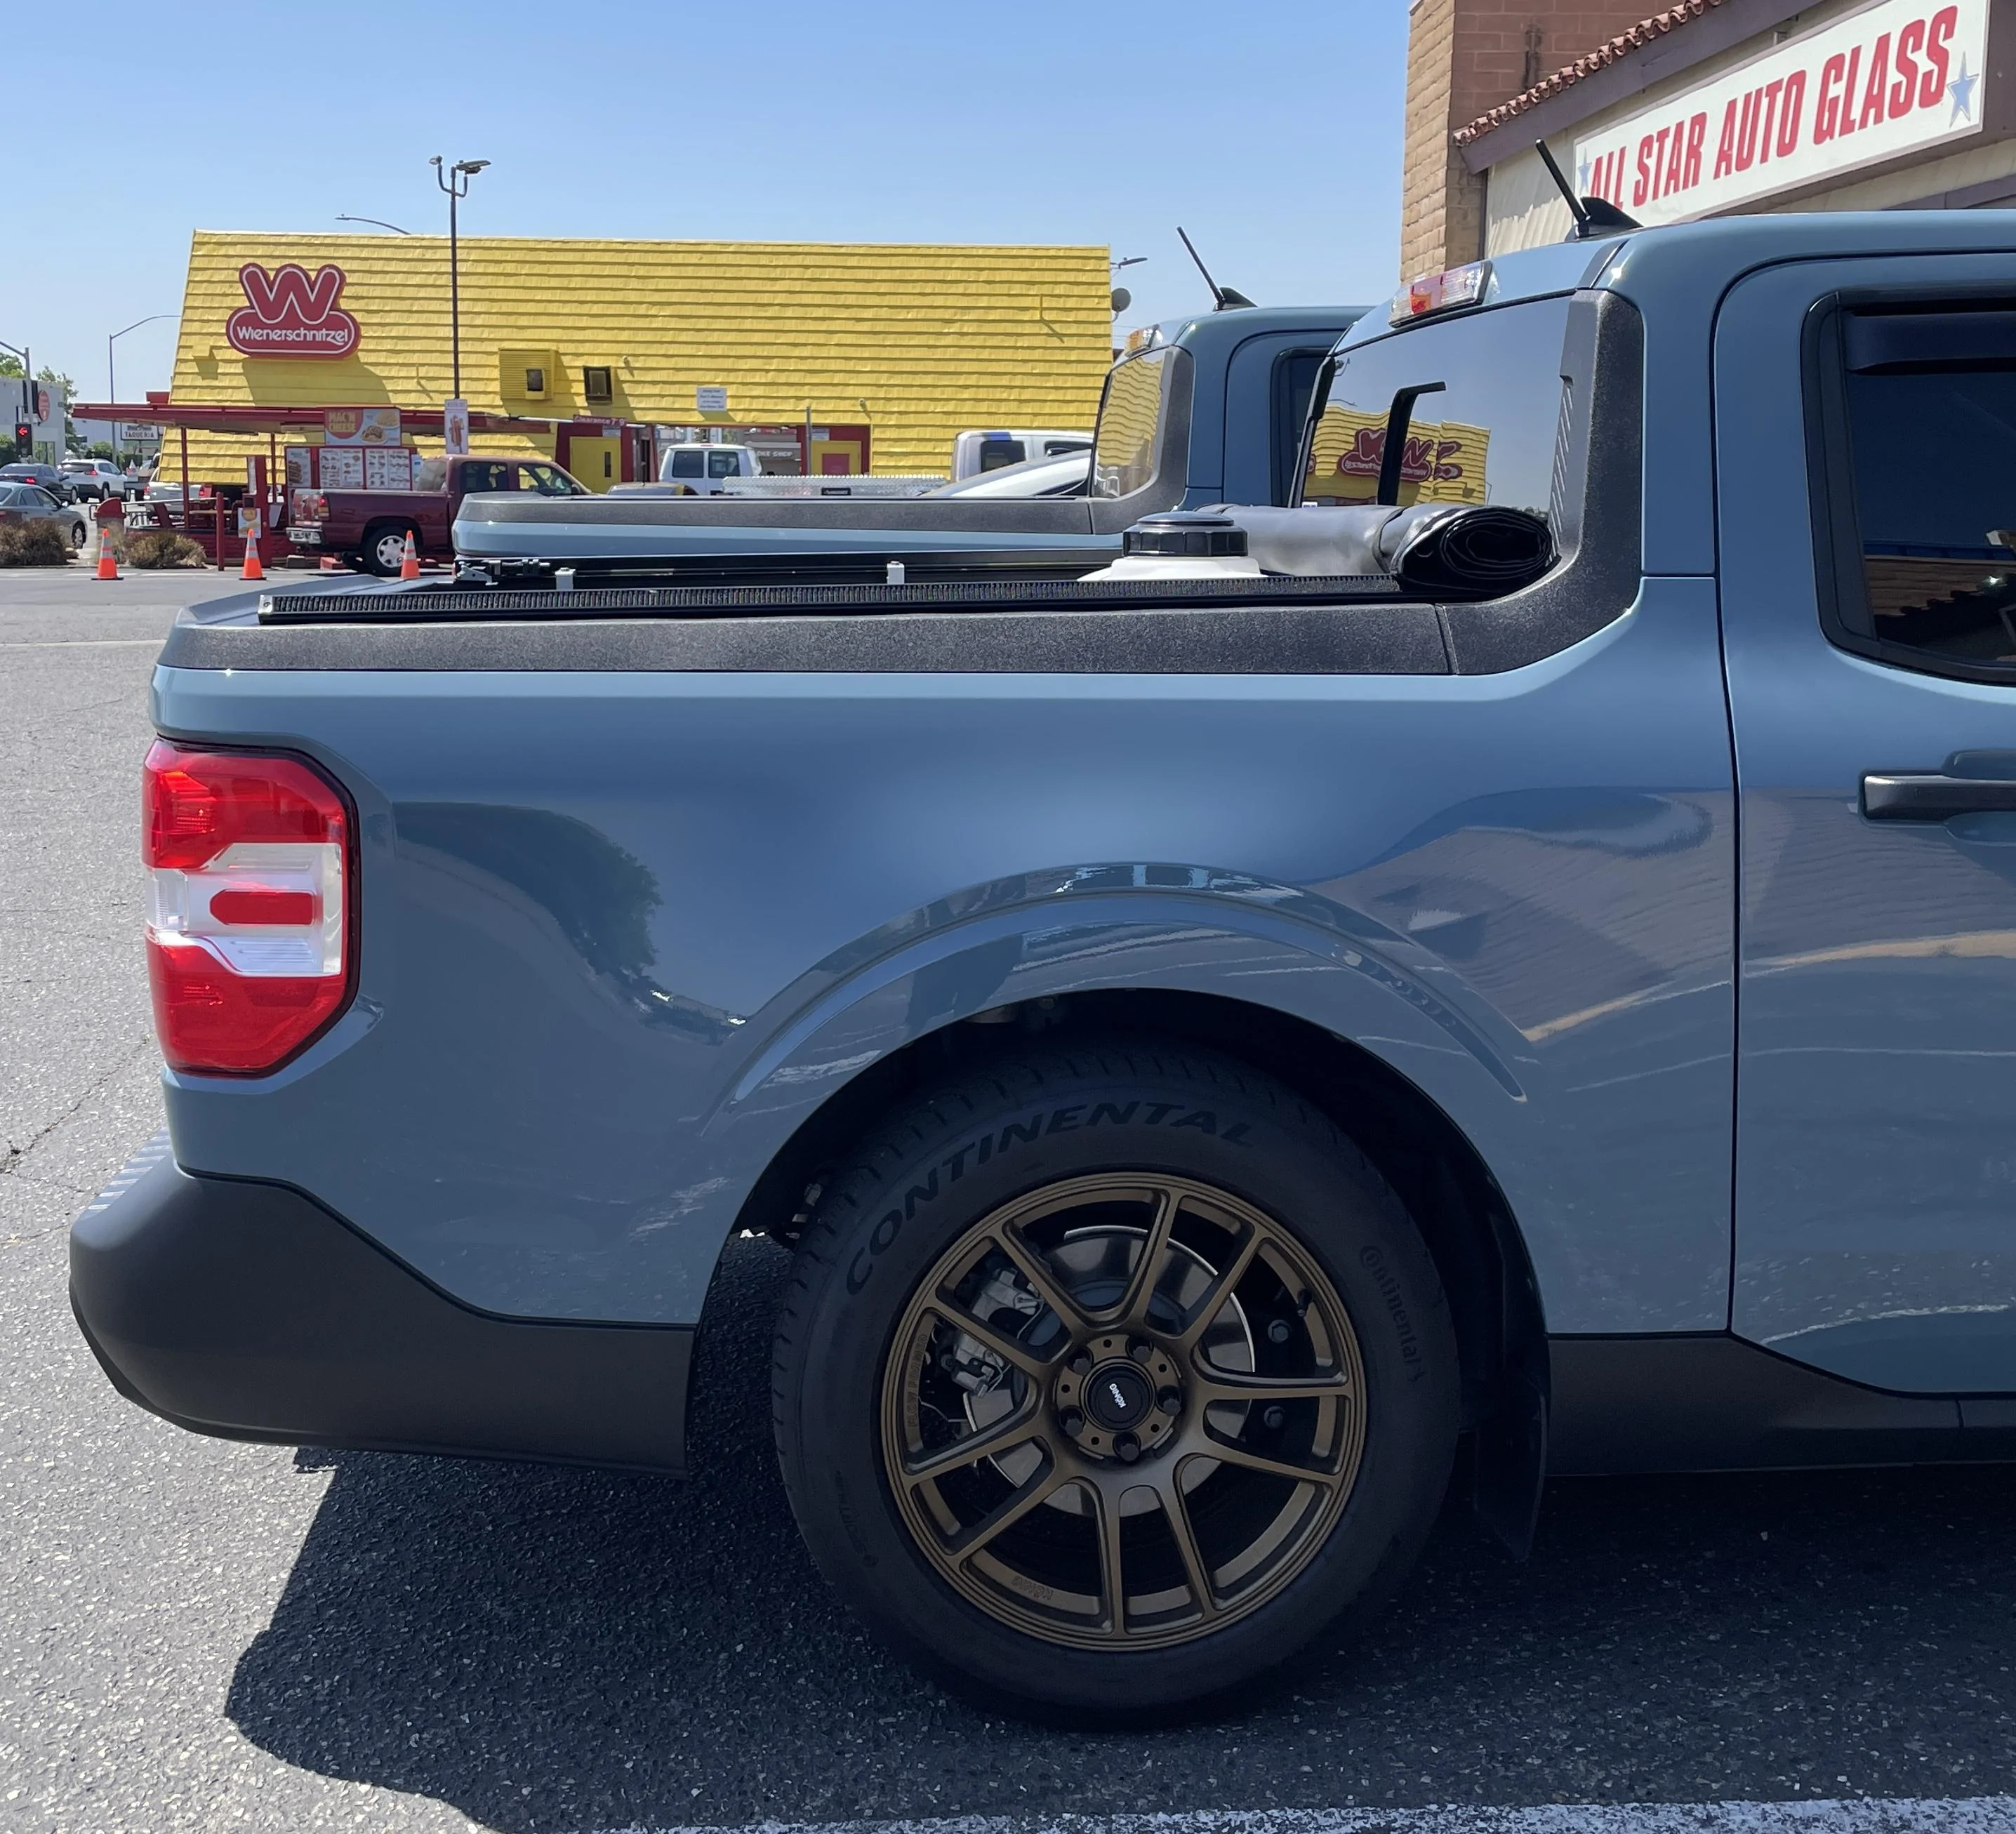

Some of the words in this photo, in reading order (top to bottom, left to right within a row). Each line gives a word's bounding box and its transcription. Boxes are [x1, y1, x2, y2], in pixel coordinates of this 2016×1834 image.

[1633, 112, 1707, 207] STAR
[1713, 69, 1807, 180] AUTO
[1812, 6, 1958, 146] GLASS
[237, 326, 349, 346] Wienerschnitzel
[847, 1101, 1254, 1296] CONTINENTAL
[1360, 1245, 1422, 1364] Continental
